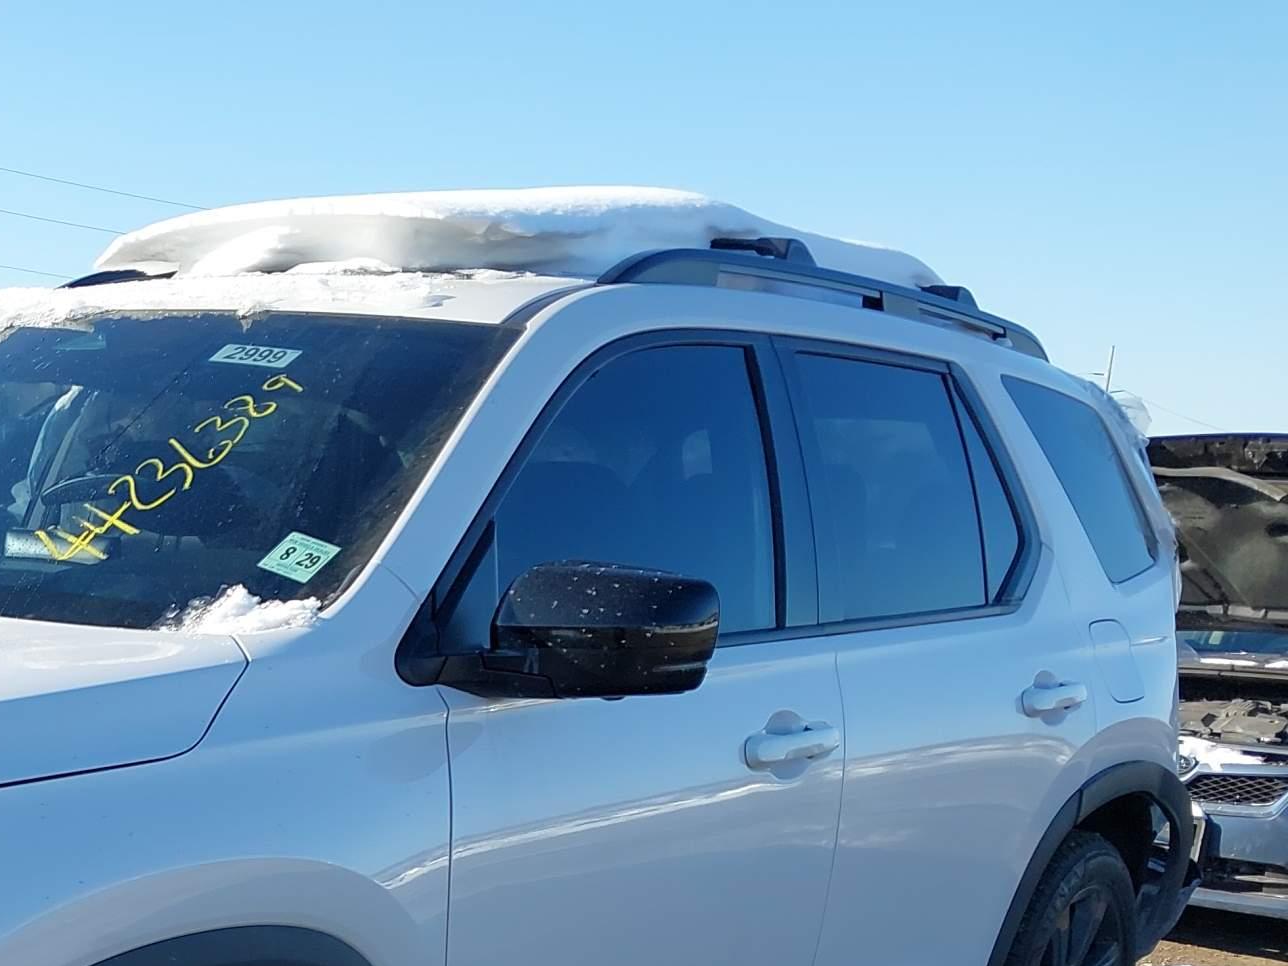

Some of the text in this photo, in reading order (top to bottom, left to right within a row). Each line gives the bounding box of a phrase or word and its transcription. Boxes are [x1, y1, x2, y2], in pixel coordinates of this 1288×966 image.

[222, 345, 288, 364] 2999
[279, 546, 298, 561] 8
[295, 552, 322, 569] 29
